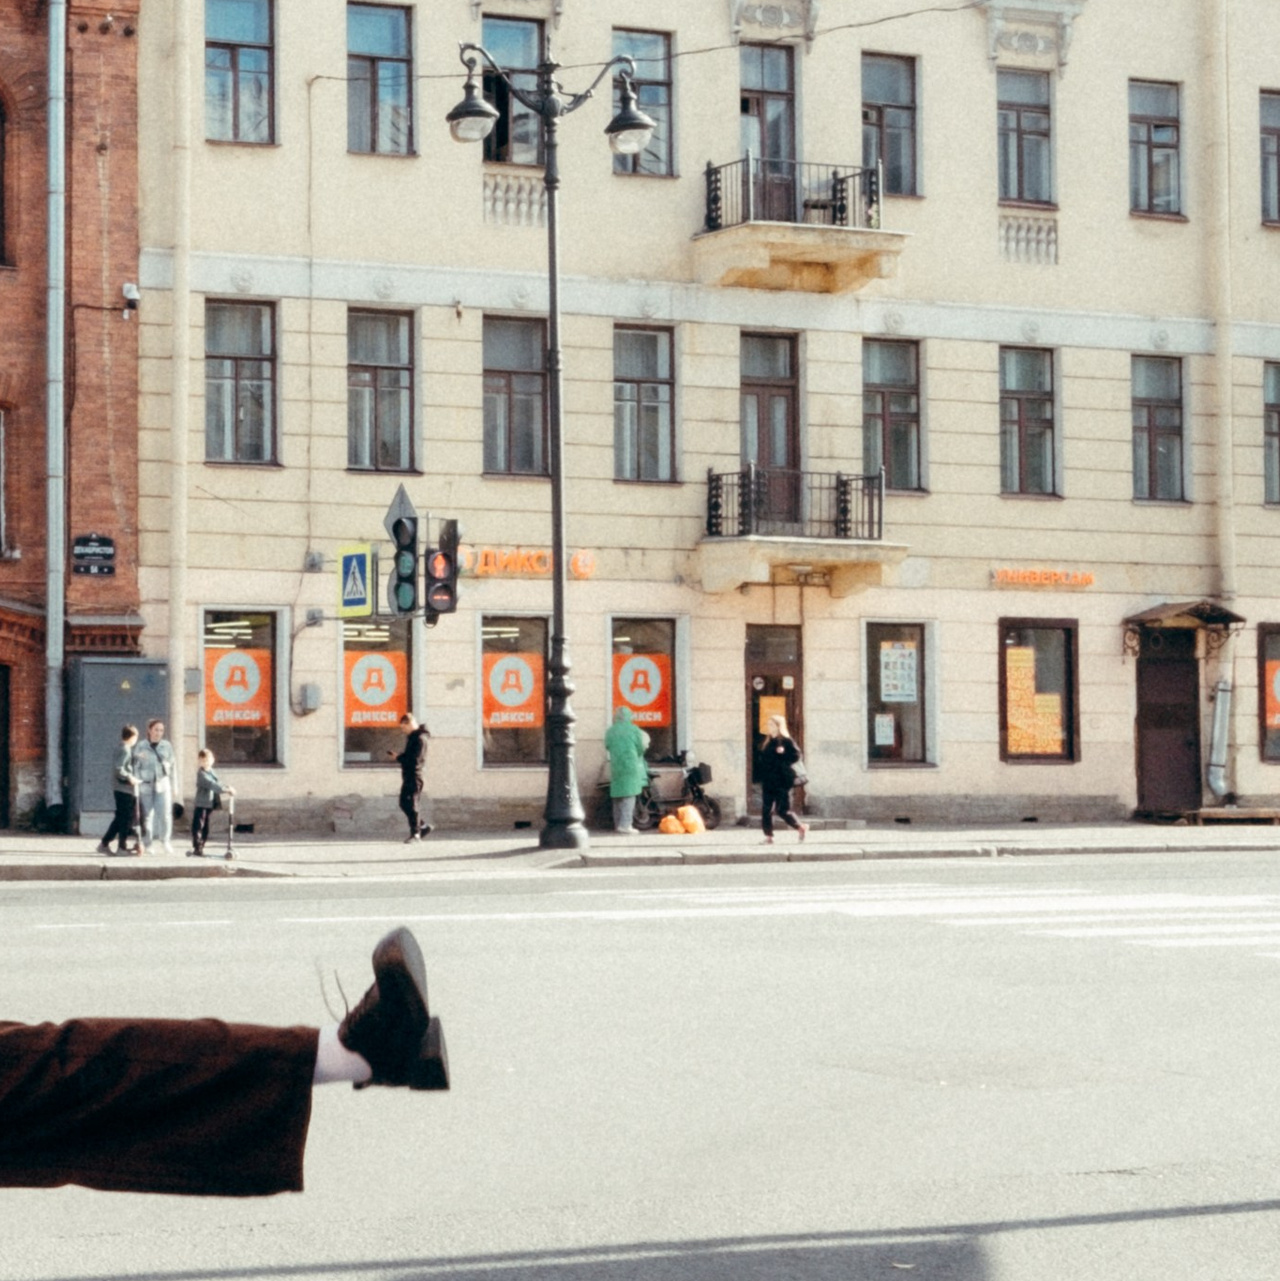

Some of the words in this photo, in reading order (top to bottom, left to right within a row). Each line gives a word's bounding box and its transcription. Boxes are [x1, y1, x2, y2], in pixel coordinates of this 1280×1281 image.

[476, 549, 554, 575] ДИКС
[213, 710, 262, 722] ДИКСИ
[351, 711, 398, 723] ДИКСИ
[490, 712, 535, 724] ДИКСИ
[631, 712, 662, 722] ИКСИ
